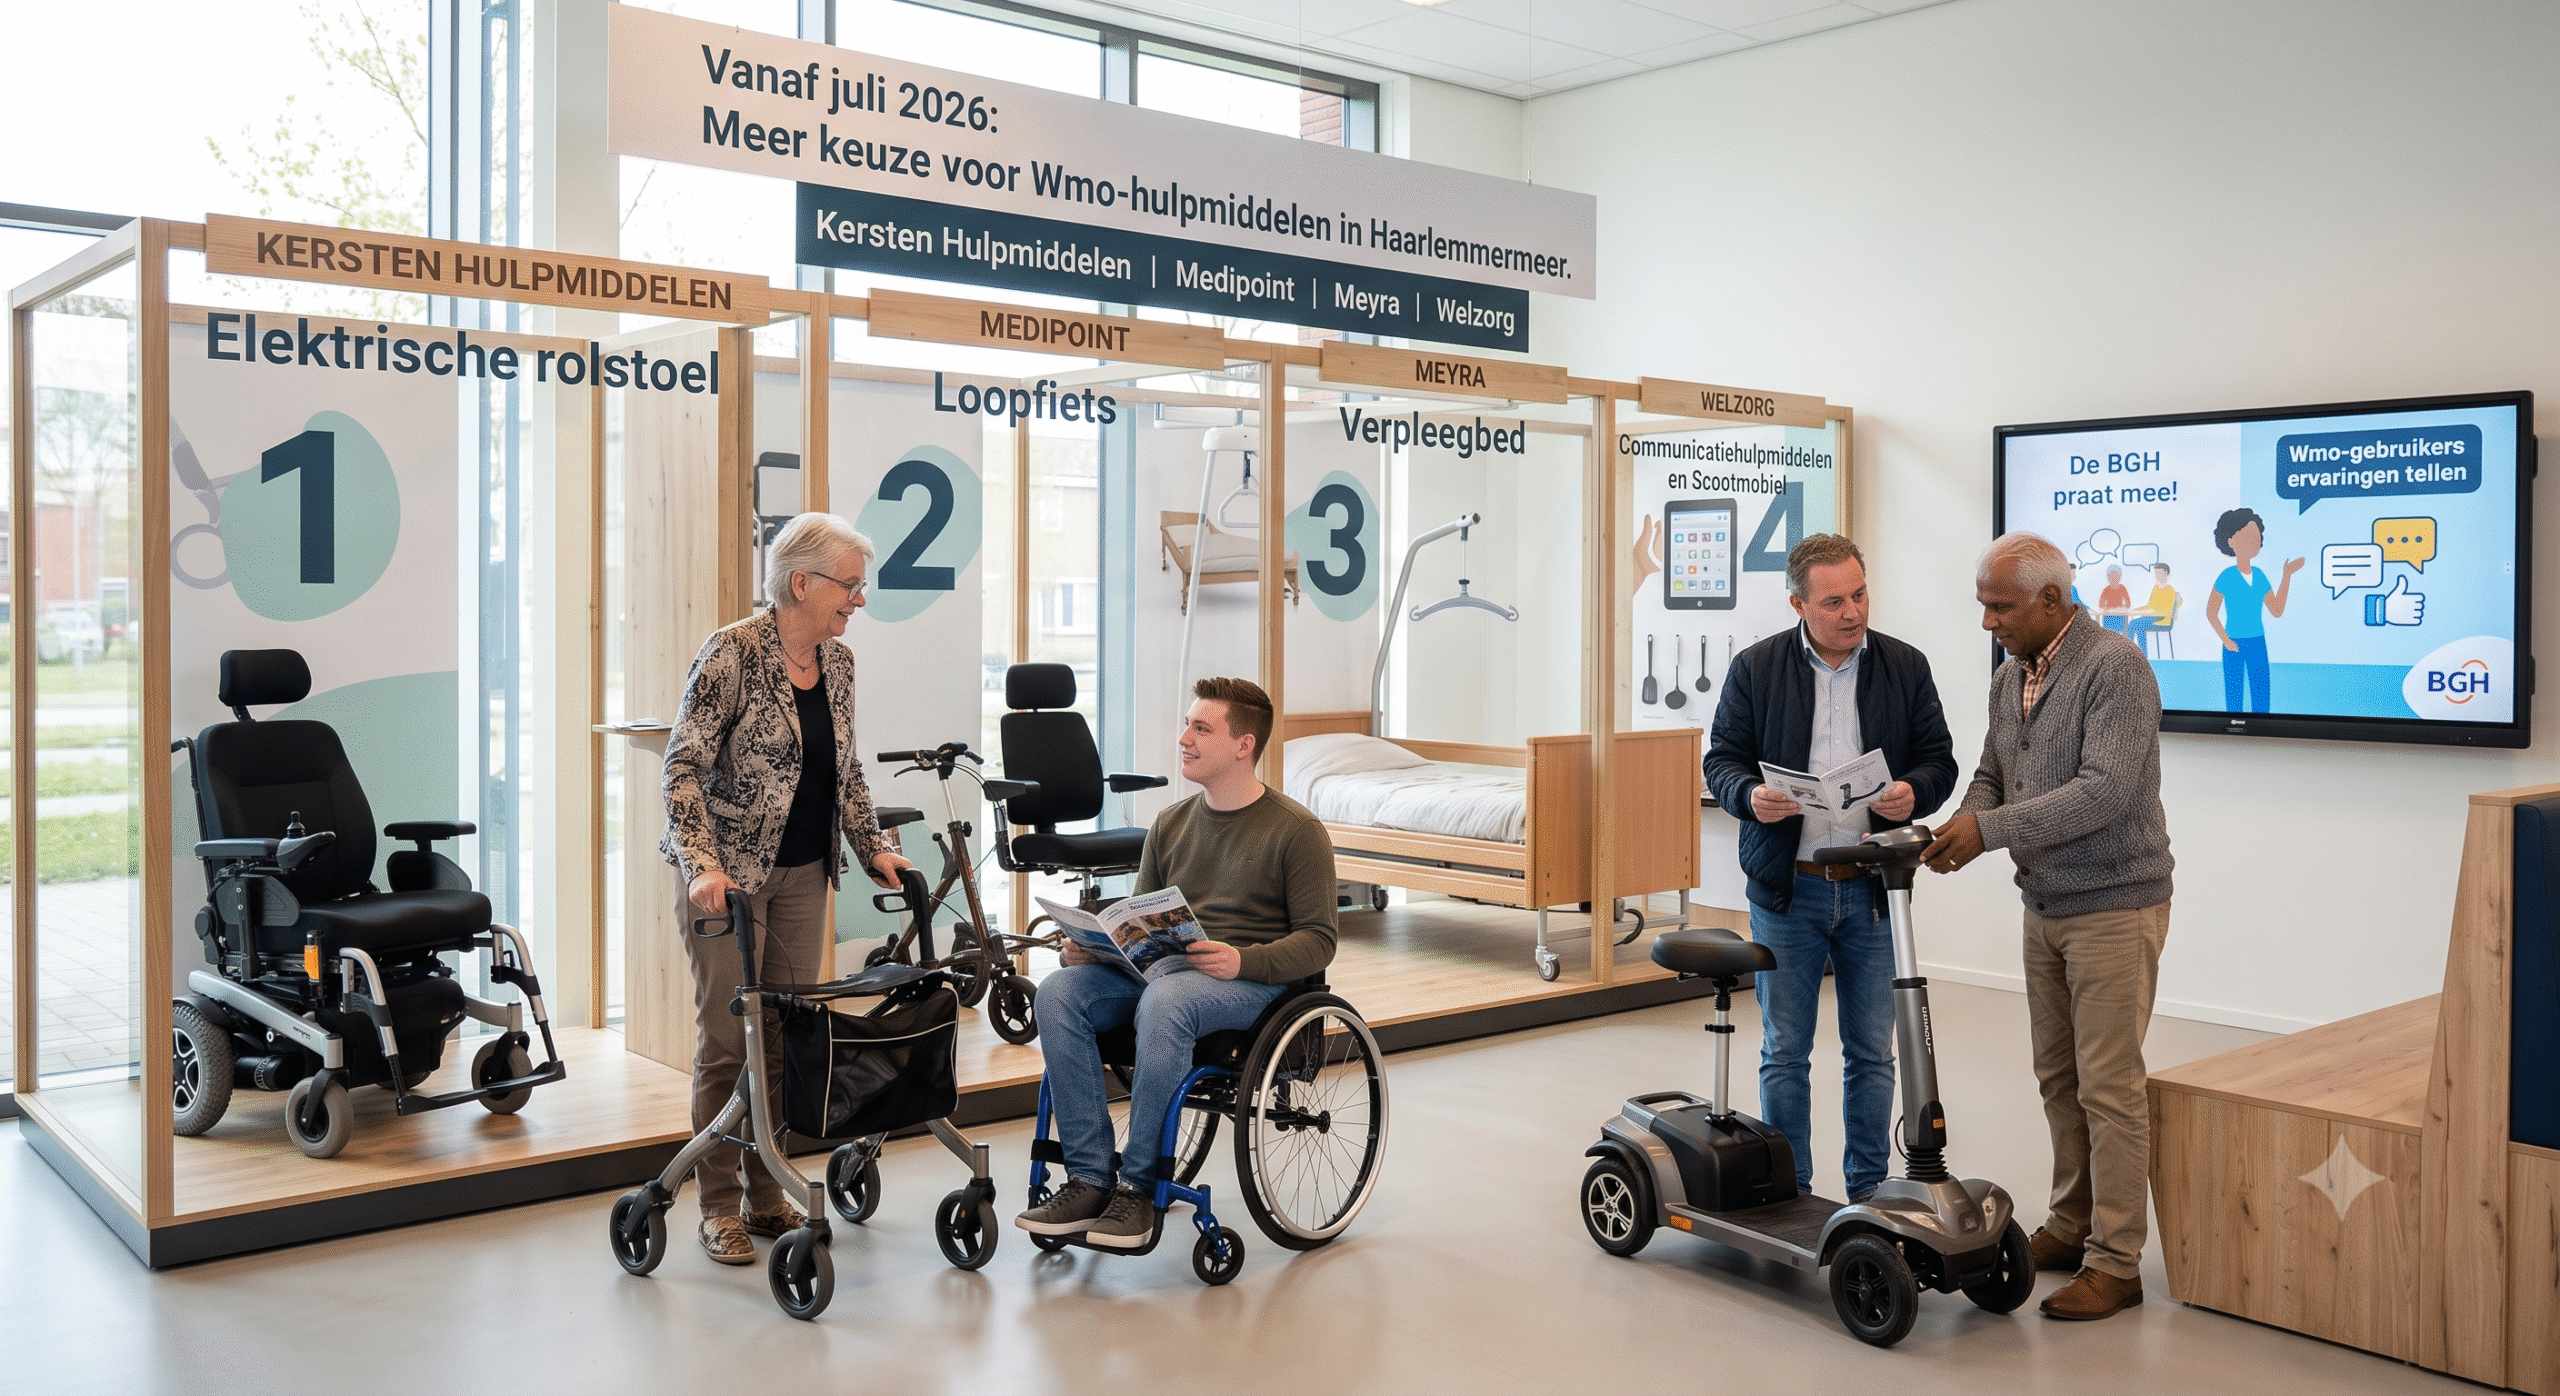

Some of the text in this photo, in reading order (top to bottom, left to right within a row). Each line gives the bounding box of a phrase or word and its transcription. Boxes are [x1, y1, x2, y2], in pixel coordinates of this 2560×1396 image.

[701, 44, 998, 133] Vanaf juli 2026:
[703, 105, 1572, 280] Meer keuze voor Wmo-hulpmiddelen in Haarlemmermeer.
[257, 231, 731, 311] KERSTEN HULPMIDDELEN
[817, 209, 933, 255] Kersten
[943, 226, 1132, 280] Hulpmiddelen
[1176, 260, 1295, 302] Medipoint
[1335, 282, 1400, 319] Meyra
[1436, 297, 1515, 338] Welzorg
[207, 312, 720, 395] Elektrische rolstoel
[980, 310, 1131, 352] MEDIPOINT
[935, 372, 1117, 428] Loopfiets
[1415, 359, 1487, 389] MEYRA
[1701, 391, 1776, 417] WELZORG
[1339, 406, 1526, 459] Verpleegbed
[1618, 433, 1833, 470] Communicatiehulpmiddelen
[2288, 437, 2466, 465] Wmo-gebruikers
[1668, 469, 1787, 495] en Scootmobiel
[2070, 451, 2161, 475] De BGH
[2286, 463, 2468, 489] ervaringen tellen
[260, 430, 336, 585] 1
[2053, 481, 2178, 511] praat mee!
[878, 460, 956, 591] 2
[1305, 483, 1367, 597] 3
[1742, 481, 1804, 590] 4
[2428, 670, 2490, 694] BGH
